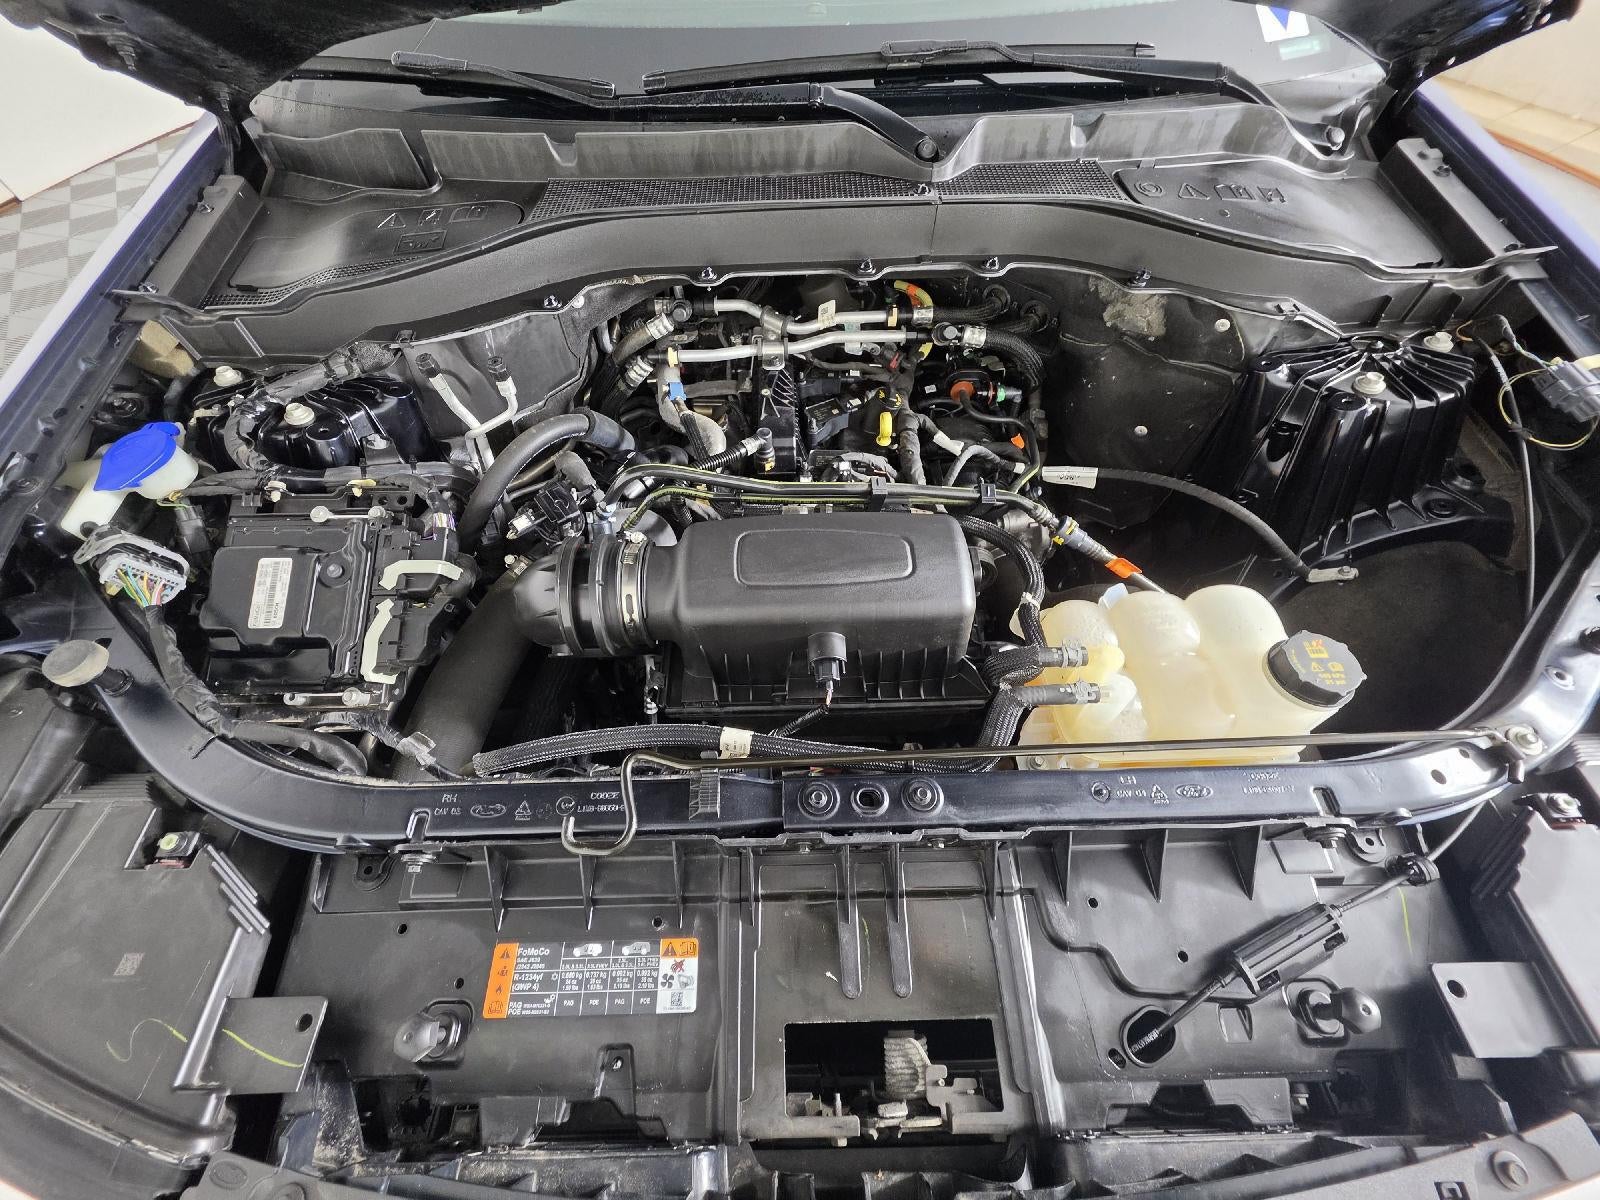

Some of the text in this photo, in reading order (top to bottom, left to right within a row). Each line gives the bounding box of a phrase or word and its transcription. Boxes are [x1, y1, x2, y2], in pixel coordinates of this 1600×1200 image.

[442, 794, 458, 802] RH
[518, 947, 550, 956] FoMoCo
[514, 973, 543, 982] R-1234yf
[512, 982, 540, 992] (GWP 4)
